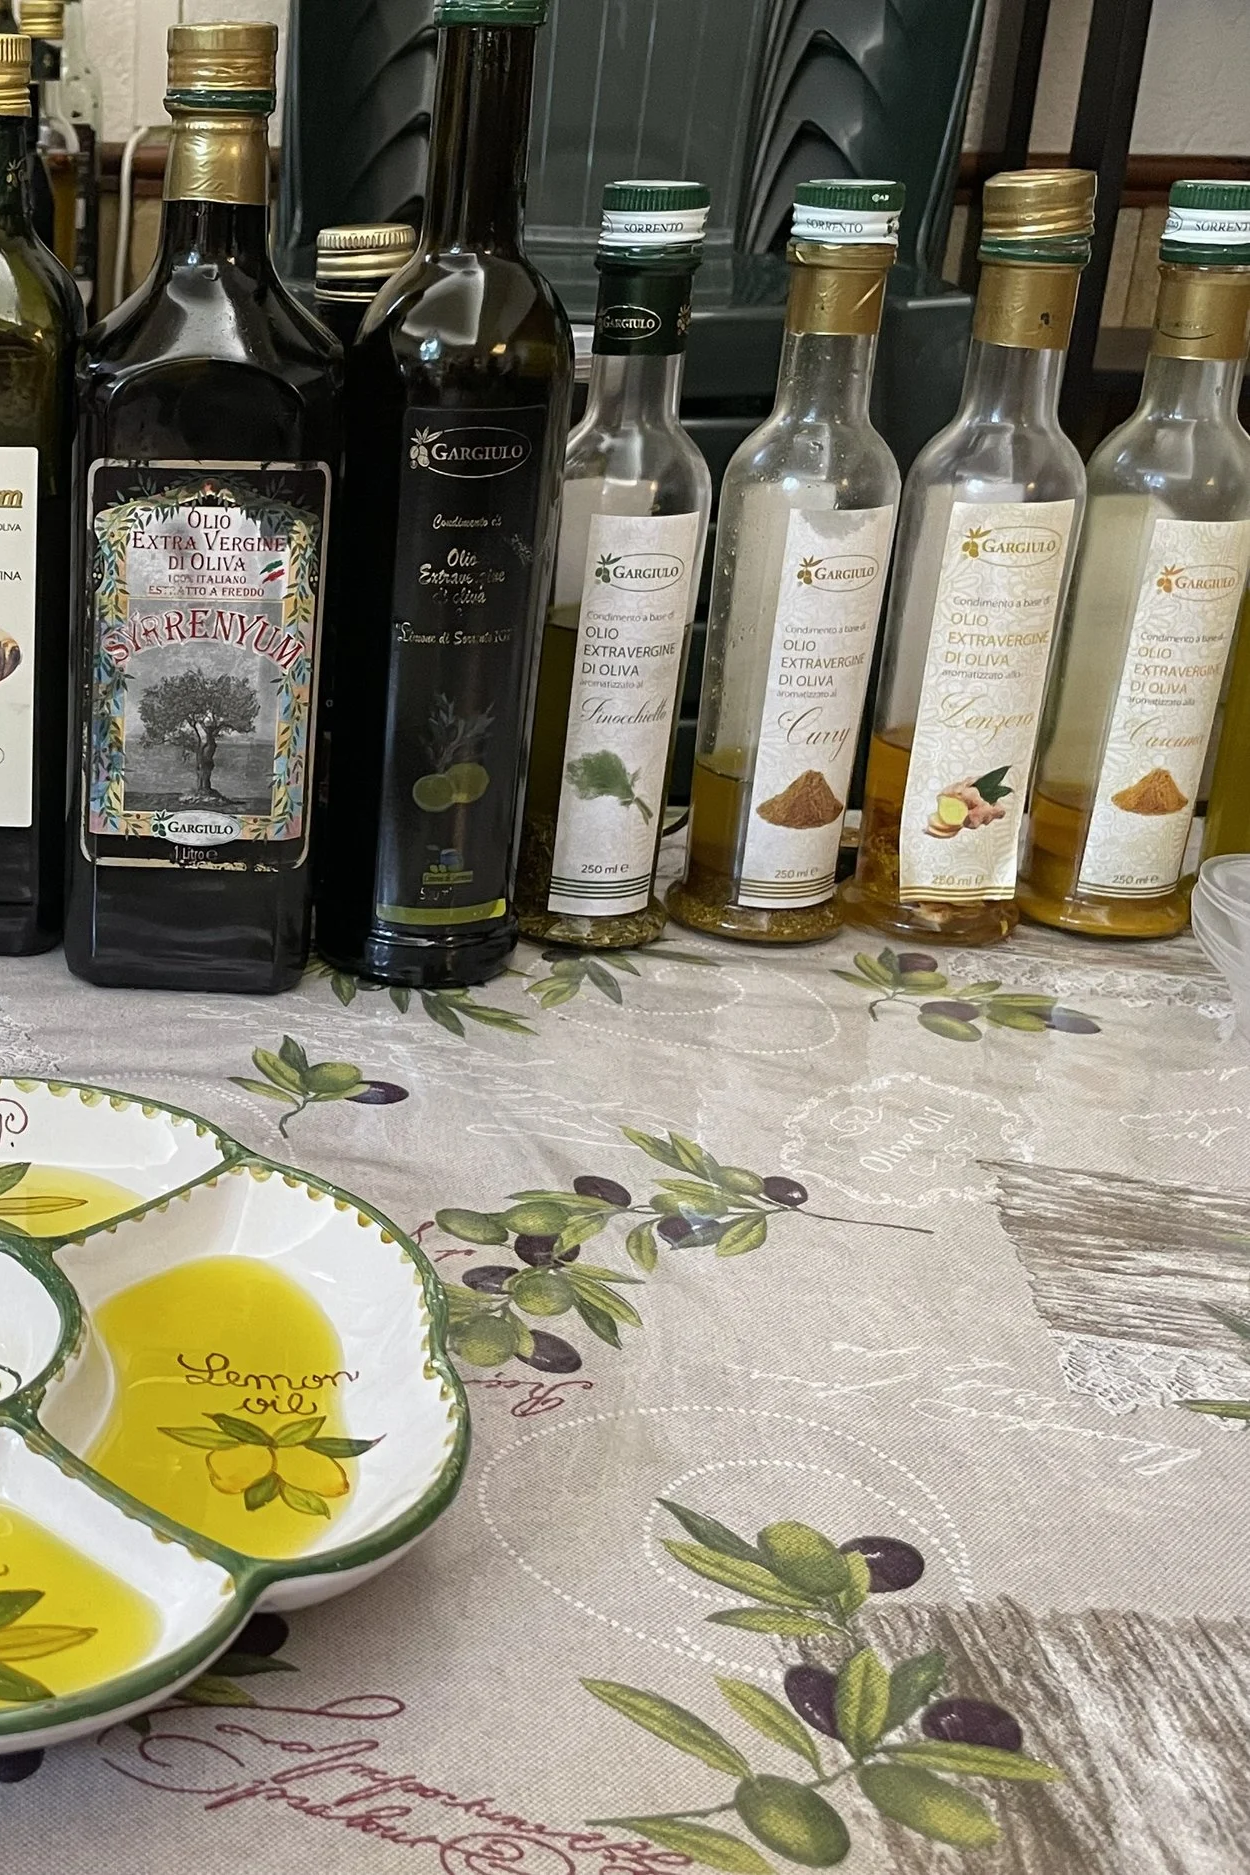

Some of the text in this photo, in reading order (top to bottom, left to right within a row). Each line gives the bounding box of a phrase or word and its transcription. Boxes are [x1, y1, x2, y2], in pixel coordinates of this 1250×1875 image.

[623, 222, 684, 233] SORRENTO
[806, 218, 864, 234] SORRENTO
[603, 315, 656, 329] GARGIULO
[431, 443, 523, 461] GARGIULO
[187, 510, 231, 530] OLIO
[432, 513, 488, 530] Condimento
[132, 530, 286, 553] EXTRA VERGINE
[982, 539, 1056, 554] GARGIULO
[168, 552, 246, 572] DI OLIVA
[447, 547, 477, 567] Olio
[613, 565, 679, 579] GARGIULO
[814, 566, 874, 580] GARGIULO
[196, 574, 247, 585] ITALIANO
[1175, 576, 1236, 590] GARGIULO
[209, 586, 218, 597] A
[221, 586, 265, 598] FREDDO
[953, 595, 1013, 608] Condimento
[586, 611, 641, 623] Condimento
[951, 613, 989, 627] OLIO
[585, 626, 619, 640] OLIO
[785, 624, 837, 635] Condimento
[438, 632, 450, 645] di
[783, 639, 816, 652] OLIO
[947, 630, 1049, 647] EXTRAVERGINE
[583, 642, 676, 658] EXTRAVERGINE
[1137, 647, 1172, 659] OLIO
[781, 652, 866, 670] EXTRAVERGINE
[944, 651, 1010, 667] DI OLIVA
[581, 662, 639, 677] DI OLIVA
[941, 669, 1004, 680] aromatizzato
[778, 674, 834, 687] DI OLIVA
[1131, 681, 1188, 694] DI OLIVA
[579, 697, 668, 726] Finocchietto
[167, 821, 234, 835] GARGIULO
[182, 847, 205, 861] Litro
[581, 864, 618, 874] 250 ml
[774, 869, 795, 879] 250
[932, 875, 955, 885] 250
[1113, 876, 1134, 885] 250
[860, 1106, 955, 1173] Olive Oil
[177, 1353, 360, 1391] Lemon
[233, 1392, 318, 1415] oil
